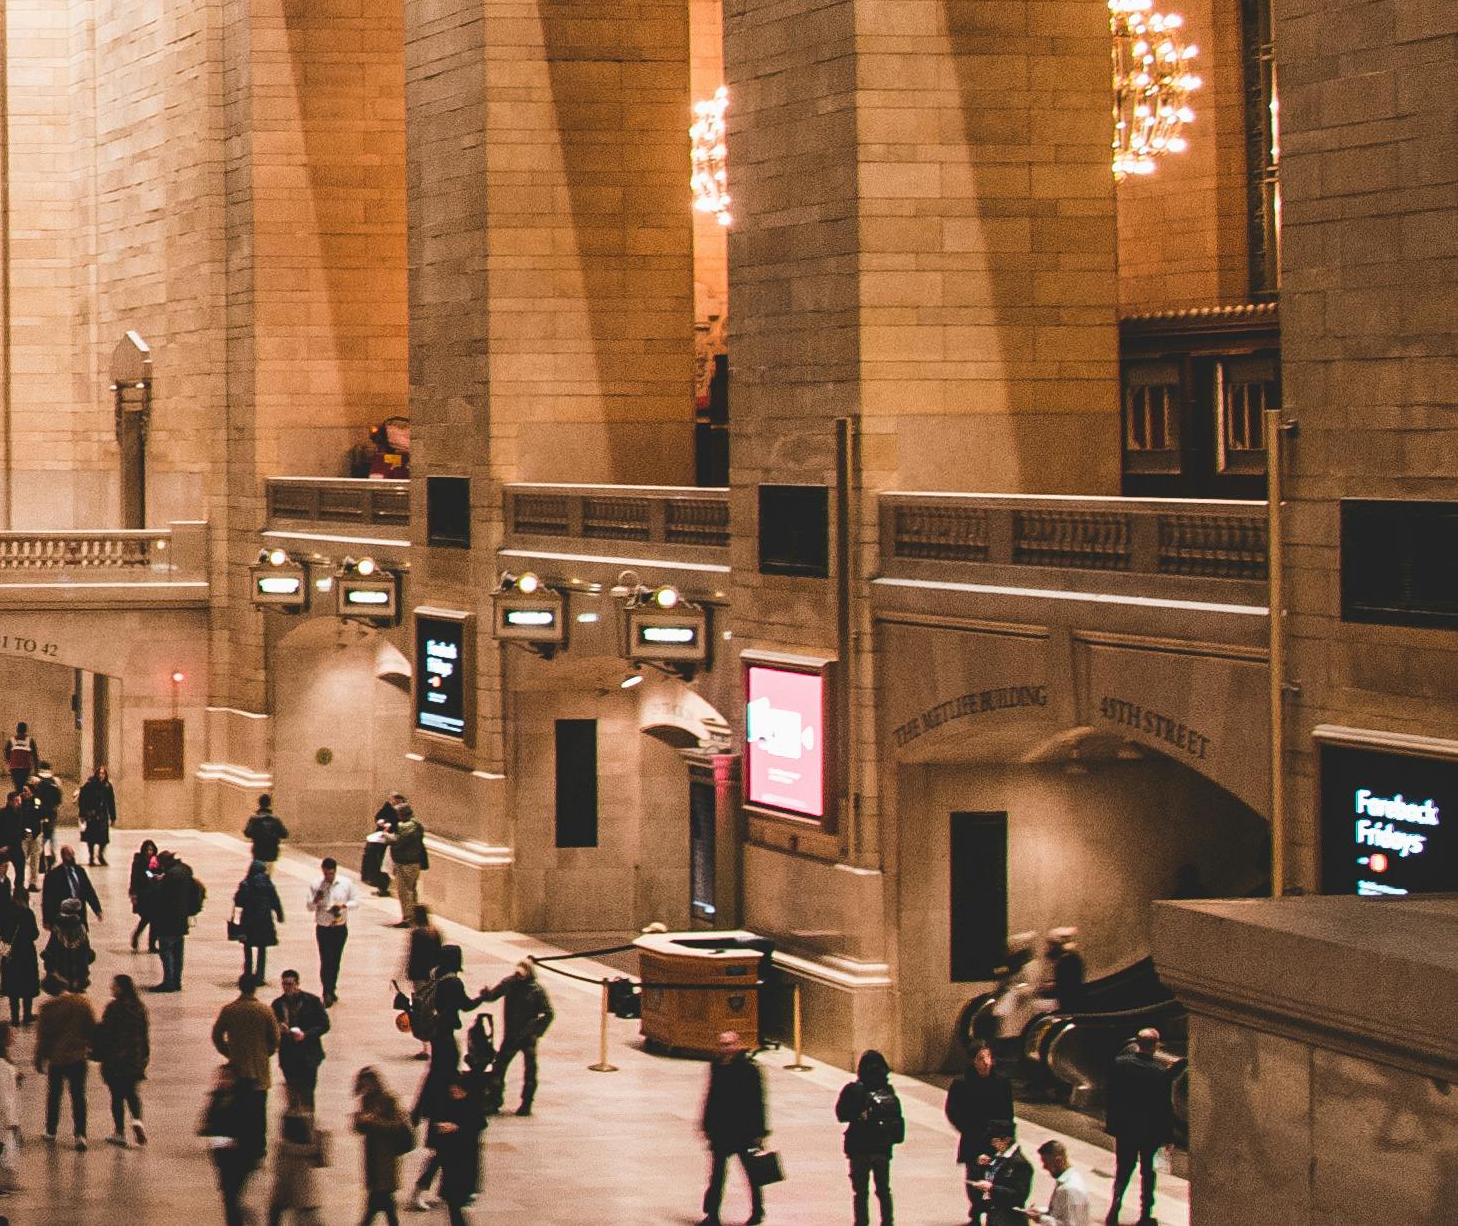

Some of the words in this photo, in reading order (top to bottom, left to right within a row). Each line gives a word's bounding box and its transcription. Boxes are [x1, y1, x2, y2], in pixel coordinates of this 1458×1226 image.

[13, 636, 37, 653] TO
[41, 643, 59, 657] 42
[892, 717, 921, 748] THE
[979, 684, 1048, 712] BUILDING
[1141, 709, 1211, 760] STREET
[1355, 819, 1428, 858] Fridays
